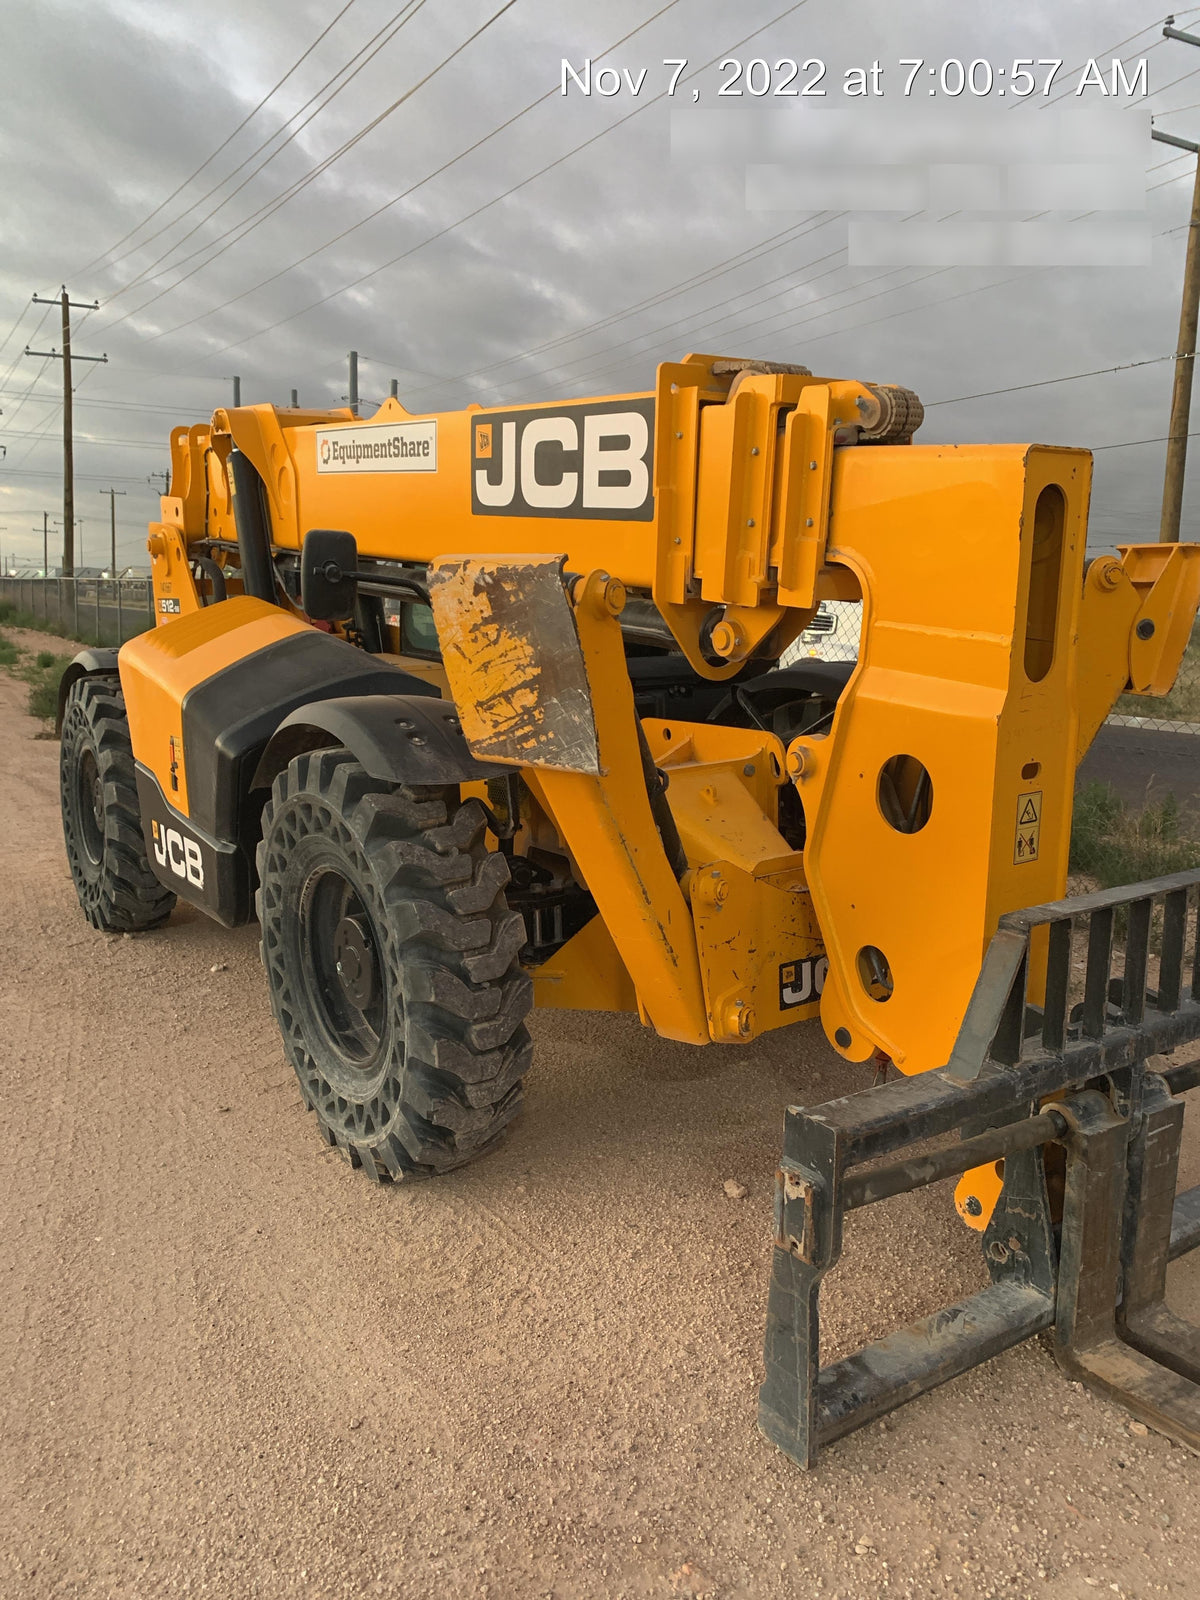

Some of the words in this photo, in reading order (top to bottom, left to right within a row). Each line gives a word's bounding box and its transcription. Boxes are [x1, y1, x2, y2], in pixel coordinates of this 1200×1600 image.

[331, 436, 430, 465] EquipmentShare
[475, 411, 649, 509] JCB
[153, 823, 204, 891] JCB
